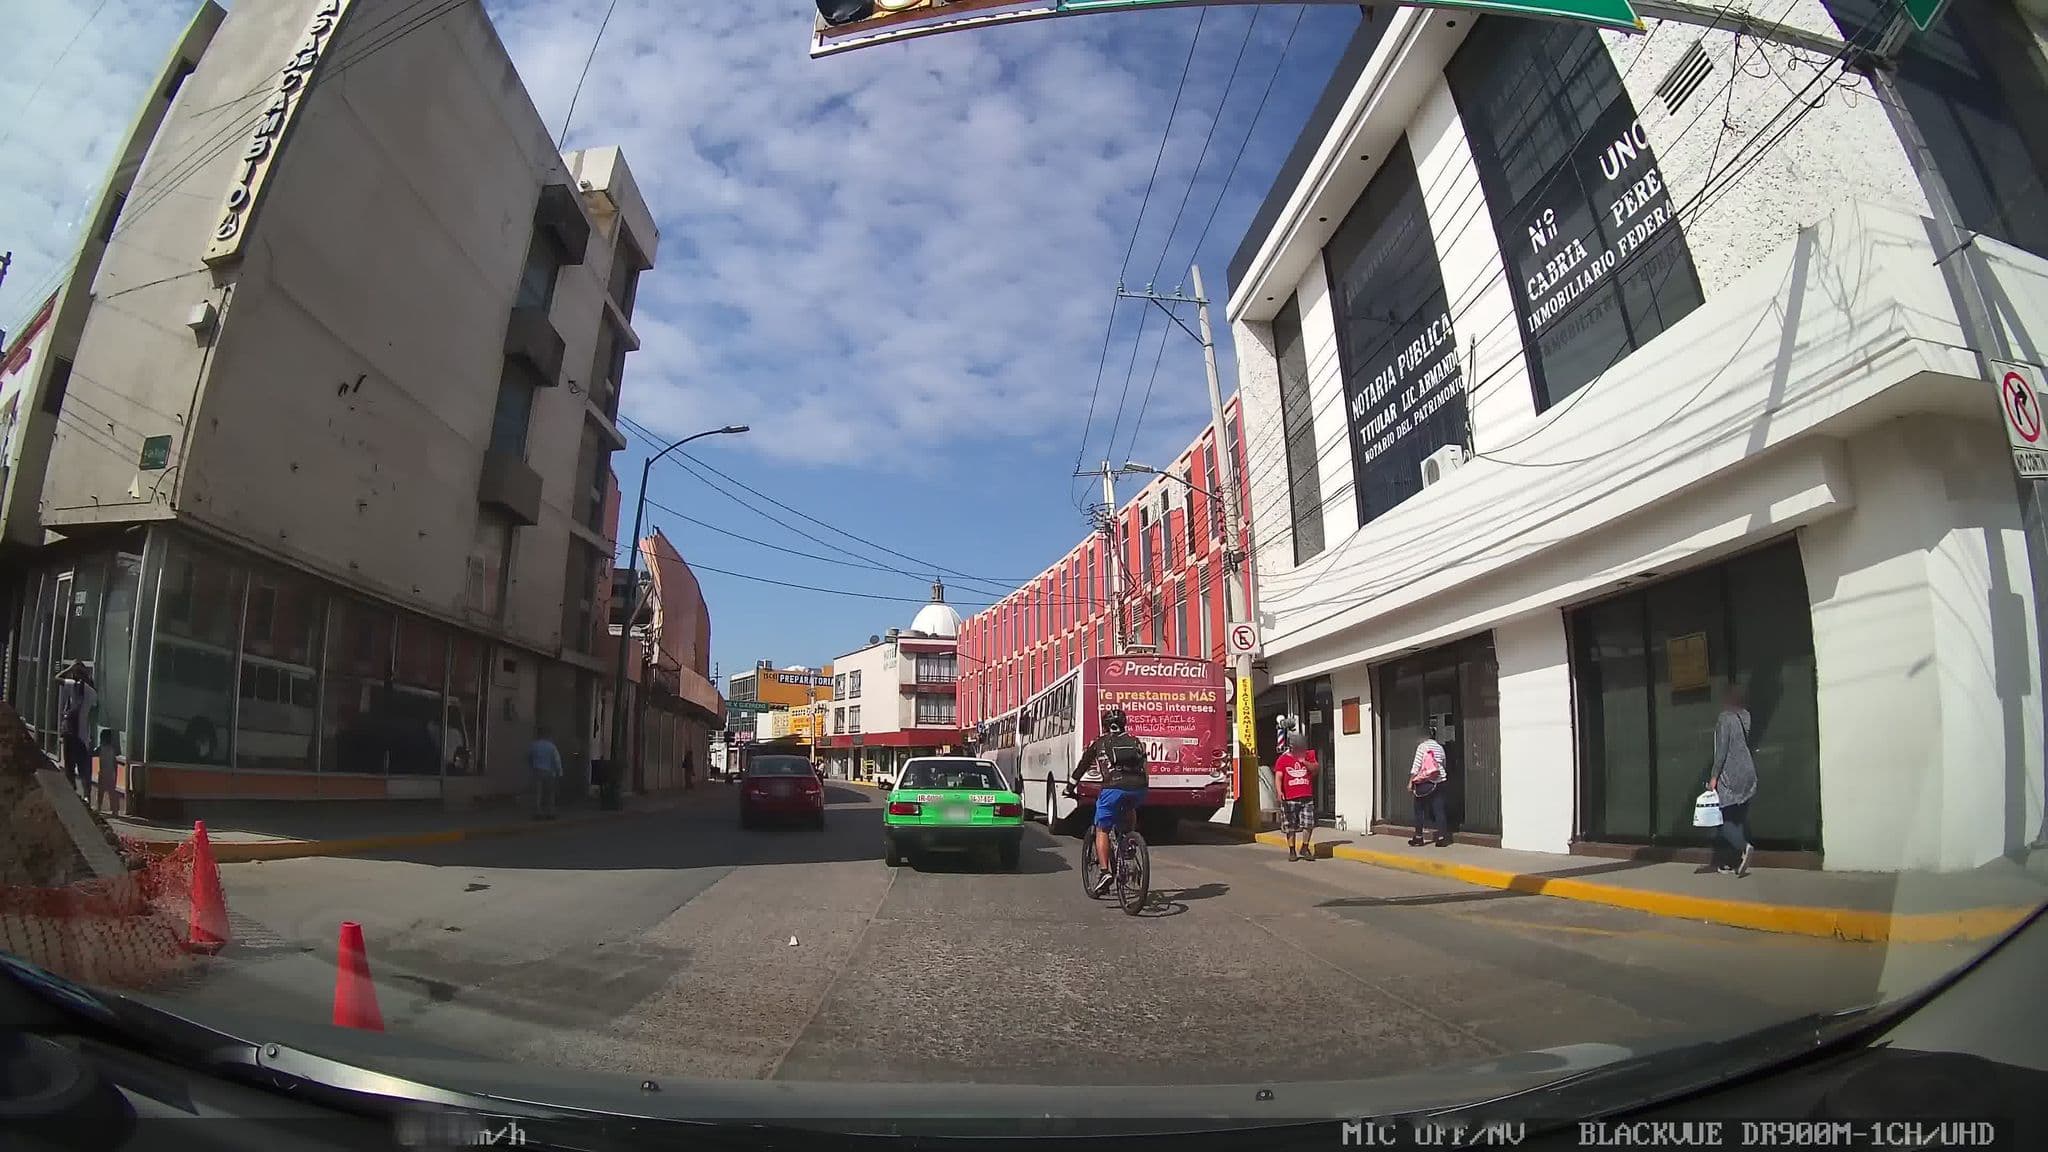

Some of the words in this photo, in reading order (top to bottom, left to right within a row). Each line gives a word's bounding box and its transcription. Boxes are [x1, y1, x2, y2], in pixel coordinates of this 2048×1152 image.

[216, 70, 303, 240] CAMBIOS
[1527, 250, 1616, 333] INMOBILIARIO
[1352, 365, 1397, 421] NOTARIA
[1397, 313, 1453, 379] PUBLICA
[1360, 402, 1398, 445] TITULAR
[1365, 431, 1395, 464] NOTARIO
[1396, 419, 1413, 440] DEL
[1413, 375, 1466, 426] PATRIMONIO
[1124, 661, 1206, 679] PrestaFácil
[1098, 689, 1112, 700] Te
[1116, 690, 1186, 703] prestamos
[1189, 688, 1216, 702] MÁS
[1098, 703, 1119, 711] con
[1122, 702, 1163, 711] MENOS
[1135, 724, 1165, 732] MEJOR
